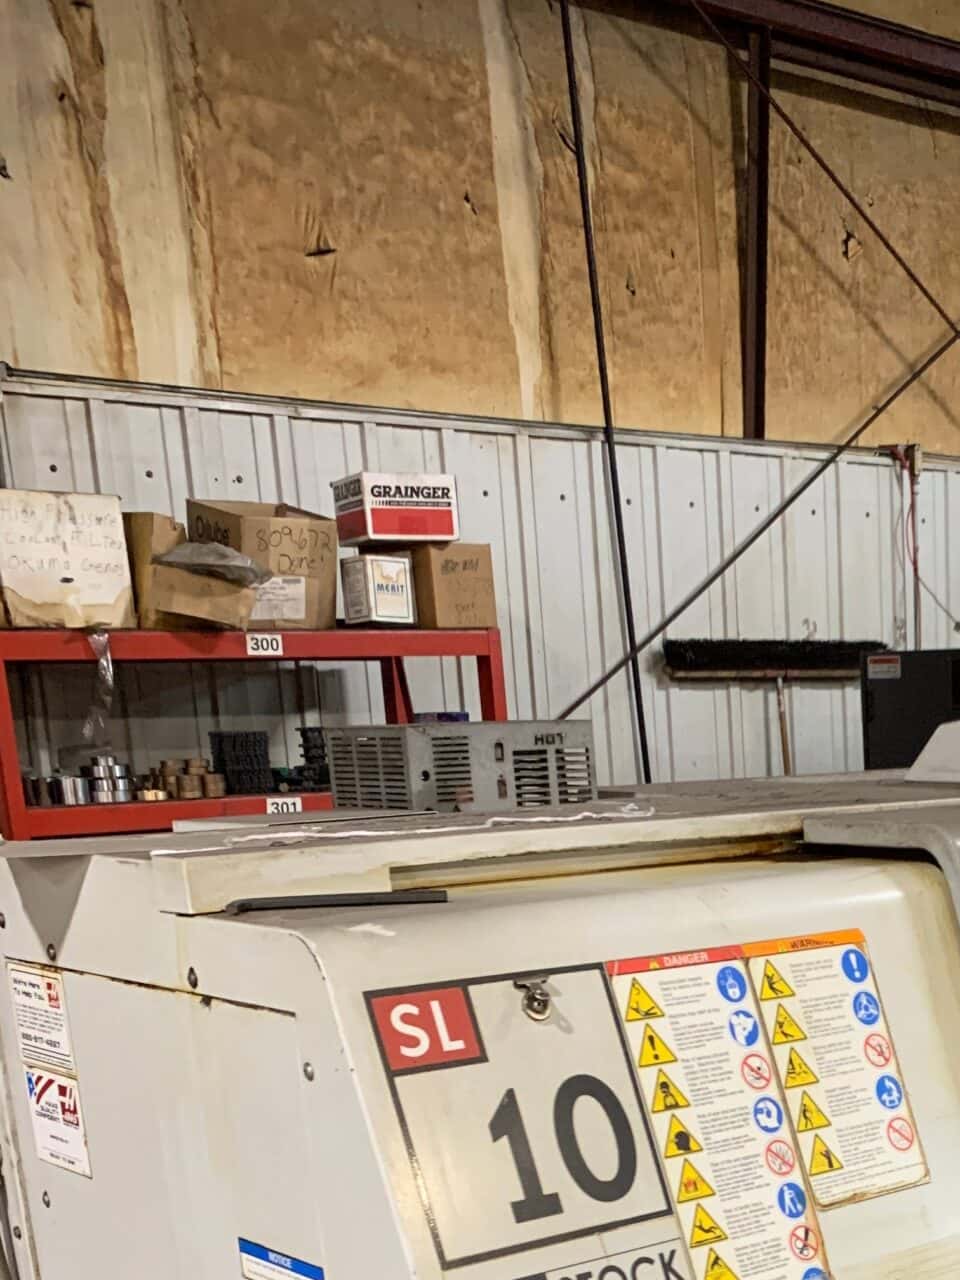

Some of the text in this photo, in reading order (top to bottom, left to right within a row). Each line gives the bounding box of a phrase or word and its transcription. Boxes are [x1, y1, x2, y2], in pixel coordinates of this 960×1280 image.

[371, 485, 450, 499] GRAINGER
[250, 637, 280, 651] 300
[535, 733, 564, 745] HOT
[271, 802, 298, 815] 301
[663, 951, 709, 967] DANGER
[390, 1000, 466, 1057] SL
[488, 1074, 637, 1224] 10
